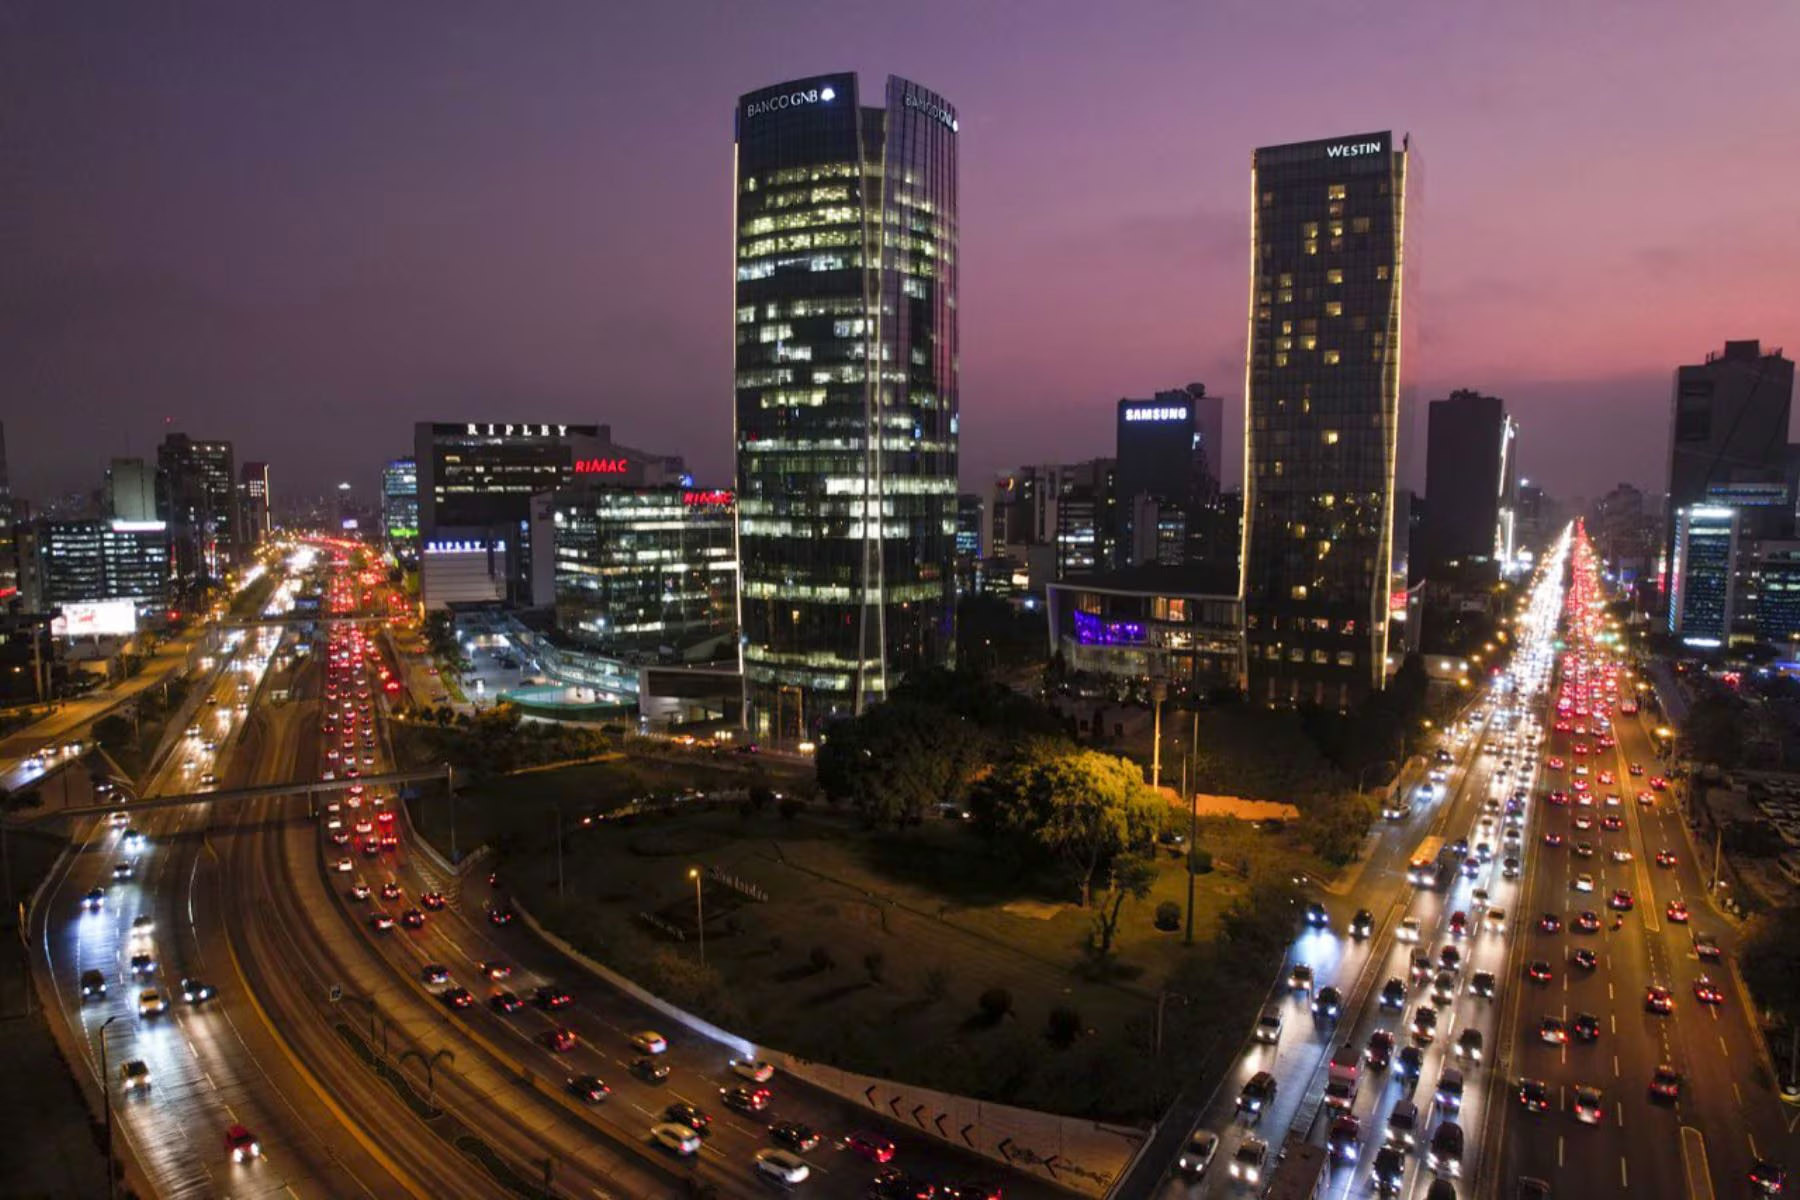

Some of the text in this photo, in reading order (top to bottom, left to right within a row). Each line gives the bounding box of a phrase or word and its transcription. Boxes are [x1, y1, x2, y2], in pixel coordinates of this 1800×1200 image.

[747, 89, 818, 118] BANCO GNB
[1326, 141, 1381, 158] WESTIN
[1125, 407, 1187, 421] SAMSUNG
[467, 423, 567, 436] RIPLEY
[575, 457, 628, 473] RIMAC
[683, 490, 733, 505] RIMAC
